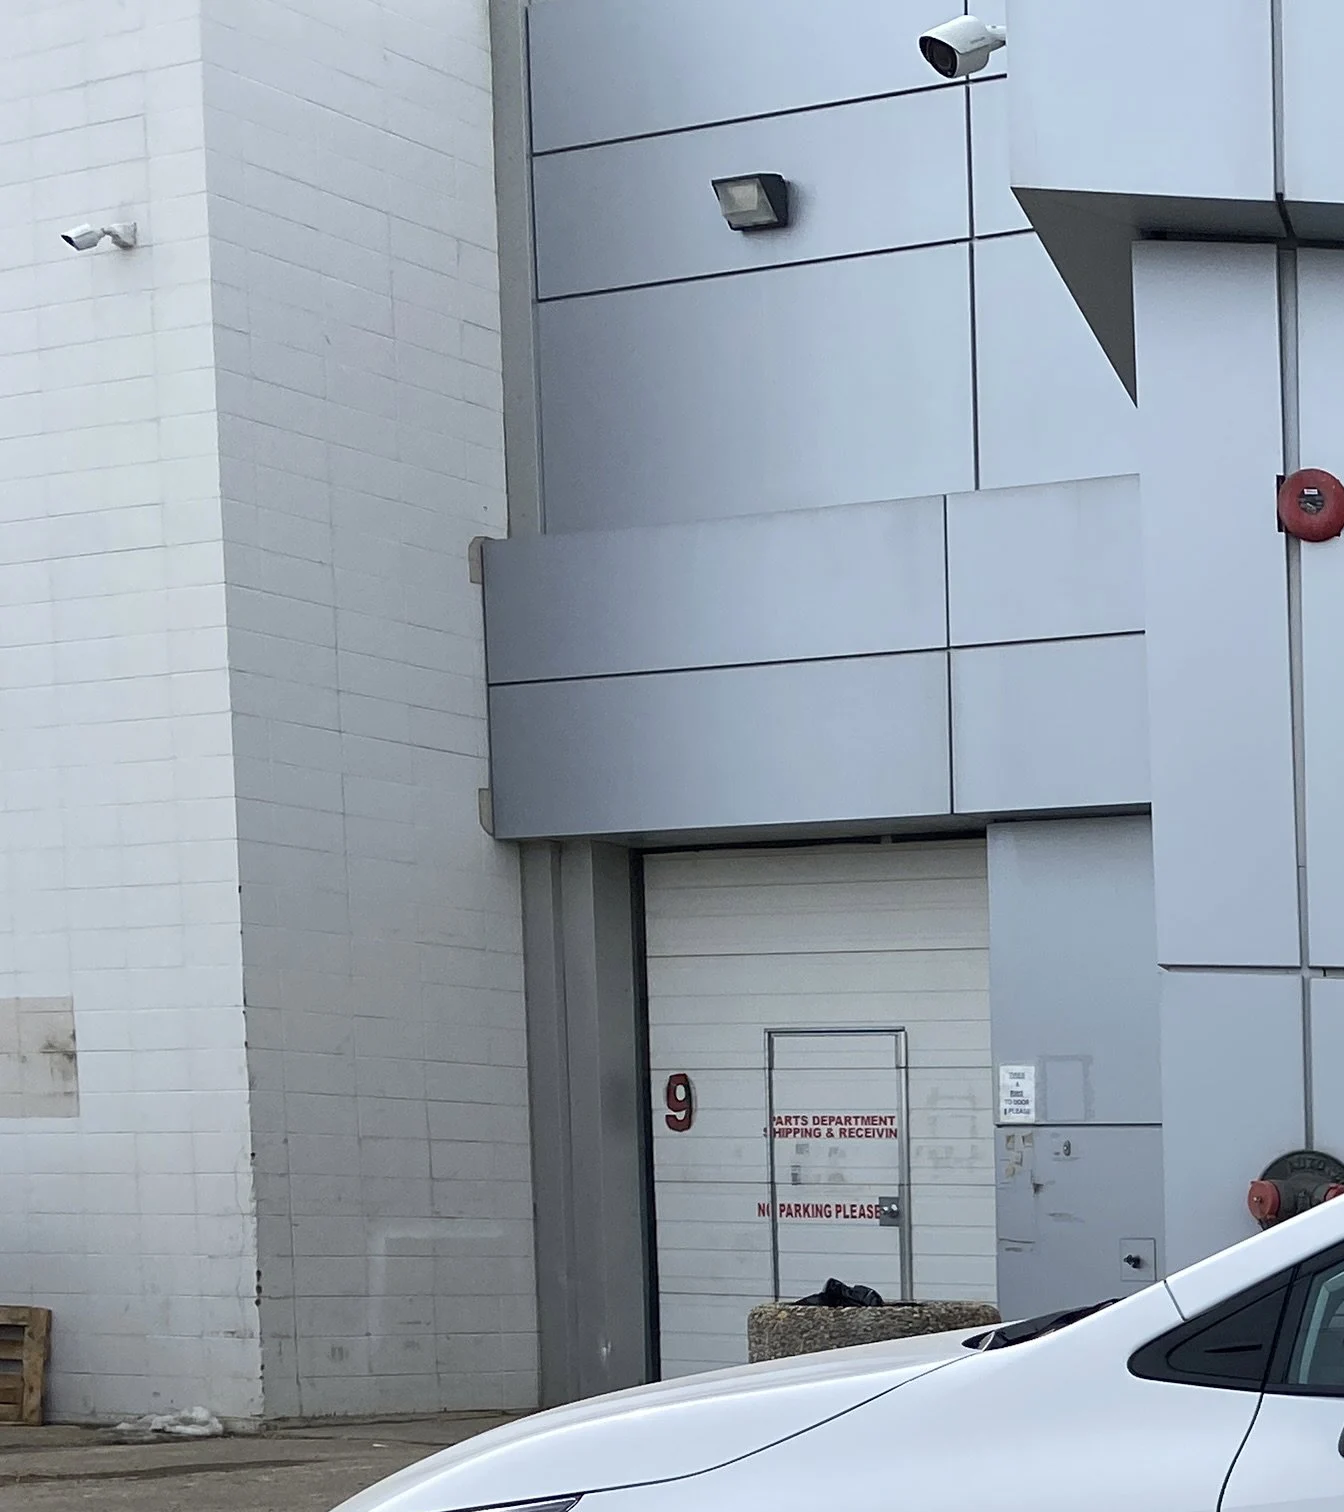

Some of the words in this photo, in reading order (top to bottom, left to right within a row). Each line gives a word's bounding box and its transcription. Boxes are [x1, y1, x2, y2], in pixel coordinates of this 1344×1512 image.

[665, 1072, 693, 1132] 9
[812, 1115, 895, 1126] DEPARTMENT
[825, 1127, 835, 1138] &
[778, 1202, 832, 1219] PARKING
